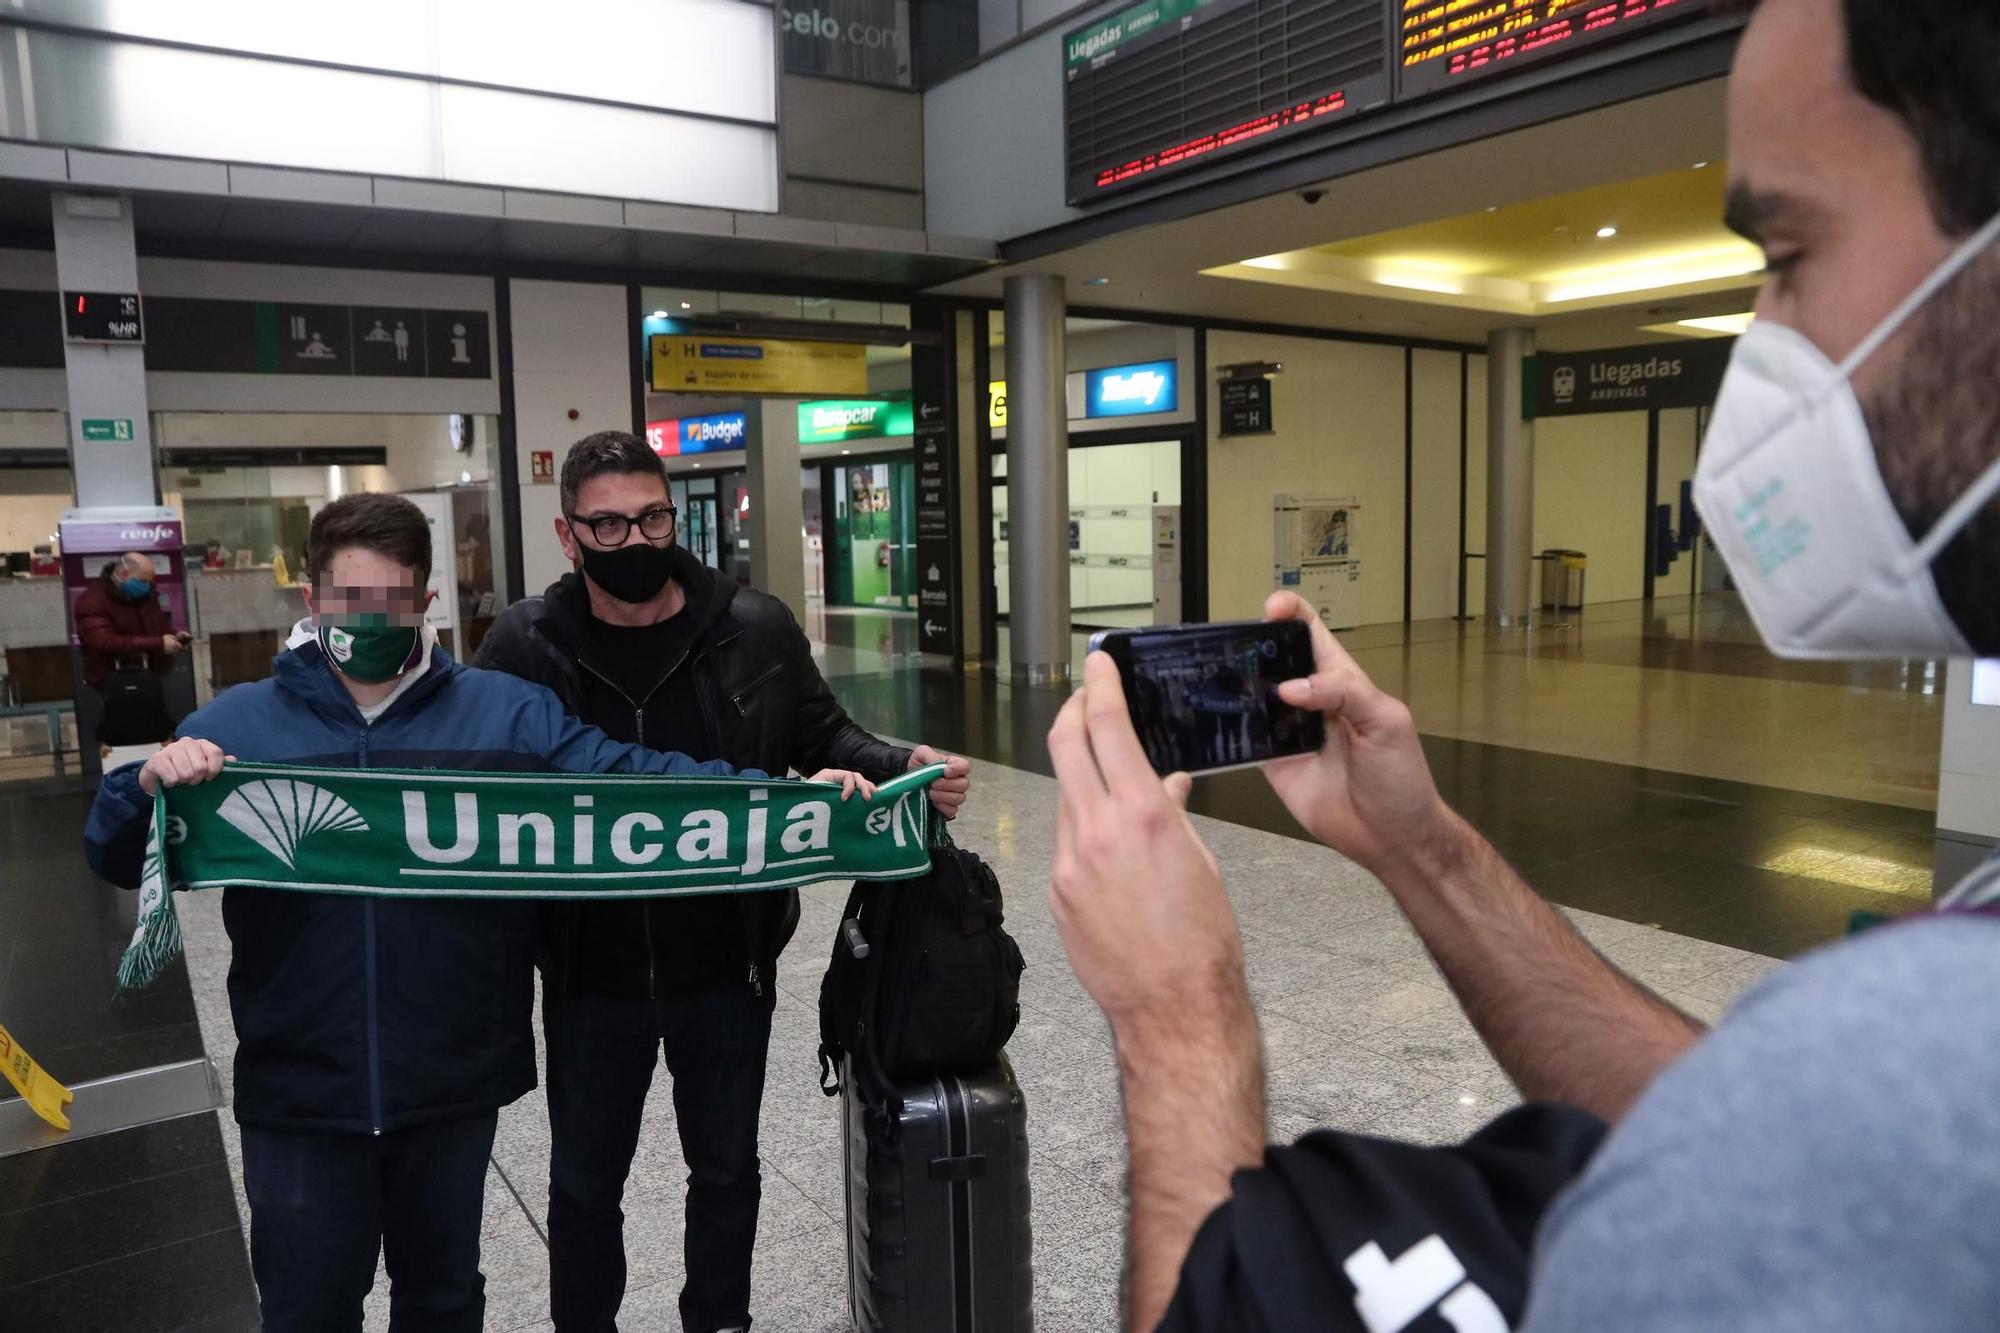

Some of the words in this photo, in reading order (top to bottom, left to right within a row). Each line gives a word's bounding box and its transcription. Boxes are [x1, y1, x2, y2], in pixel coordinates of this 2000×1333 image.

[1070, 24, 1122, 60] Llegadas
[1590, 357, 1682, 385] Llegadas
[1591, 386, 1648, 400] ARRIVALS
[813, 406, 877, 427] Europcar
[646, 428, 663, 451] IS
[702, 419, 743, 444] Budget
[120, 524, 174, 543] renfe
[402, 788, 832, 876] Unicaja
